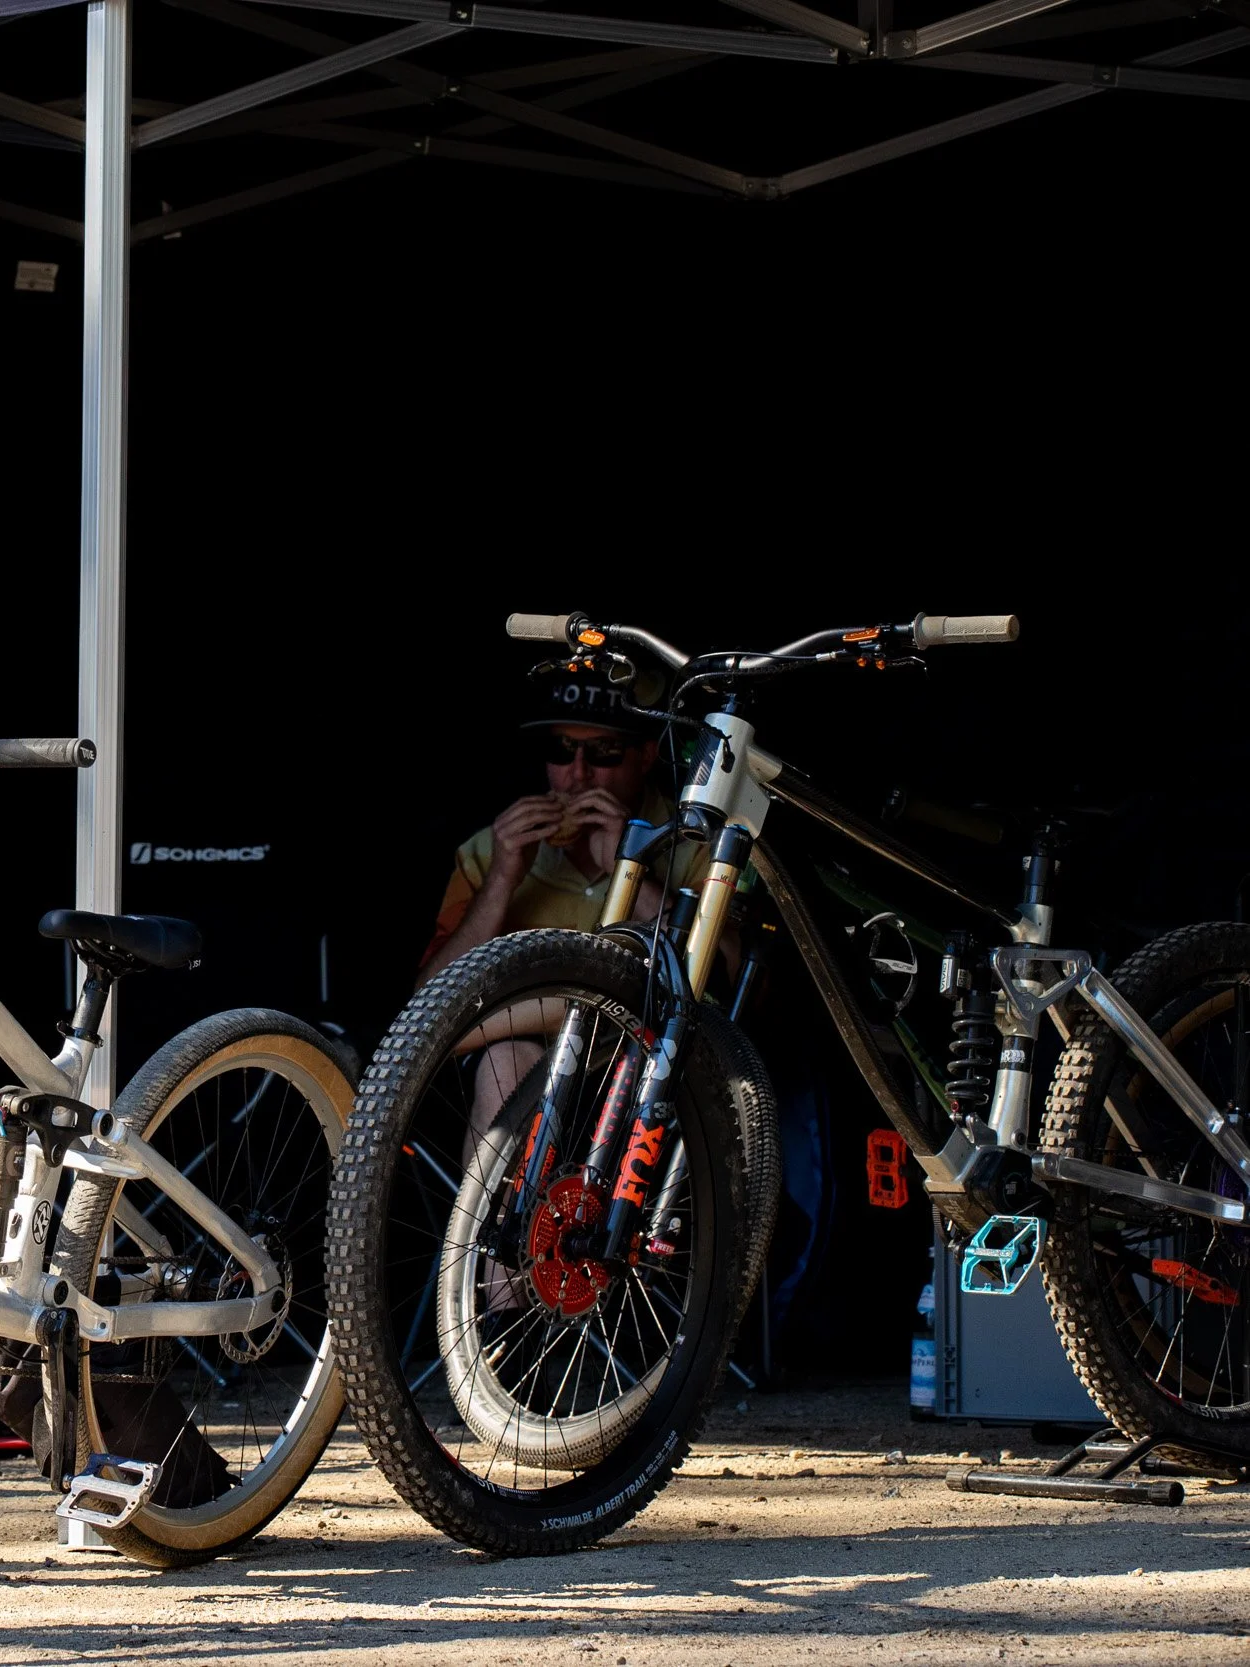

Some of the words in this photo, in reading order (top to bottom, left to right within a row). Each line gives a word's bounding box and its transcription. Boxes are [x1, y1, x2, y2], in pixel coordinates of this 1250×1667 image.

[612, 1117, 665, 1208] FOX
[548, 1510, 595, 1530] SCHWALBE
[594, 1497, 626, 1520] ALBERT
[625, 1473, 649, 1499] TRAIL
